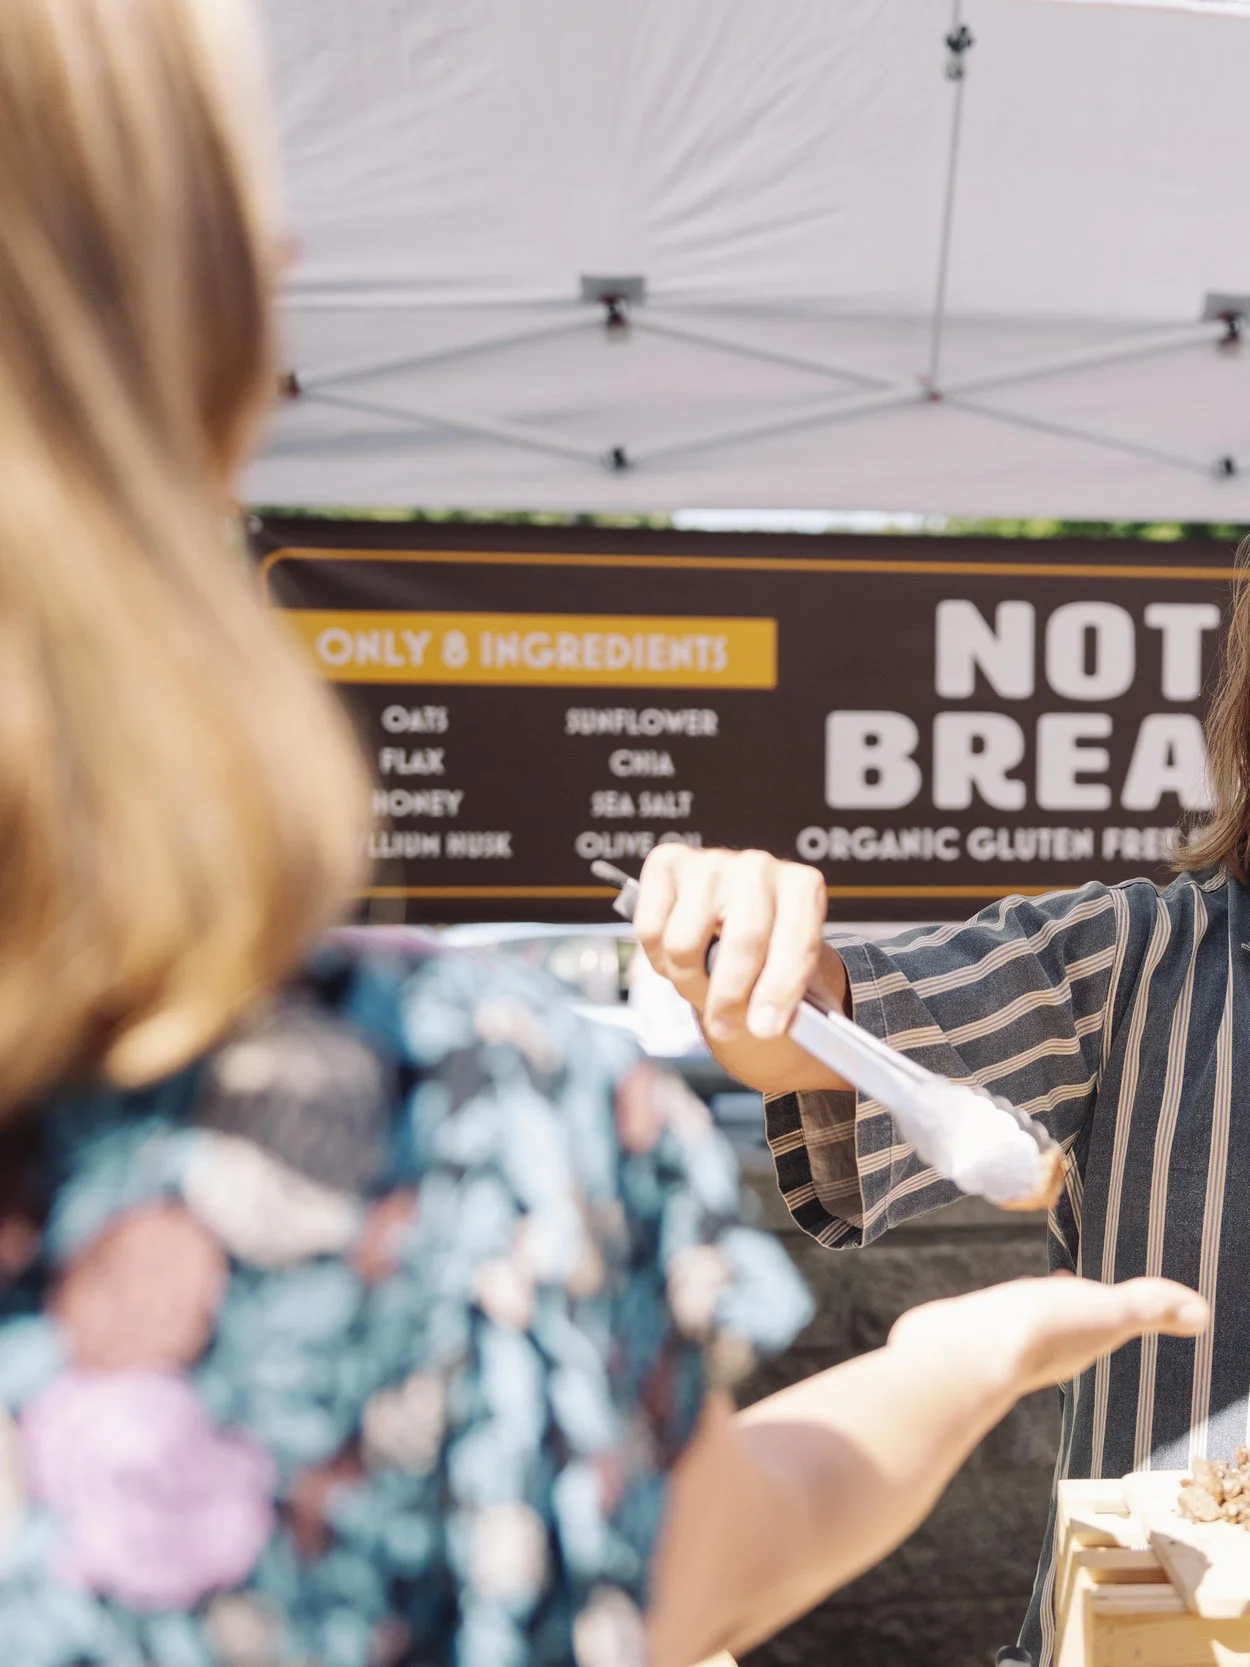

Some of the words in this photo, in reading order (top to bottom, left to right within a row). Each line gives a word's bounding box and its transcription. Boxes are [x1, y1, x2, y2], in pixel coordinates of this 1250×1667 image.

[317, 628, 430, 667] ONLY
[442, 631, 468, 667] 8
[481, 632, 728, 671] INGREDIENTS
[935, 599, 1221, 700] NOT
[381, 705, 448, 733] OATS
[565, 708, 718, 736] SUNFLOWER
[379, 748, 445, 775] FLAX
[609, 749, 675, 777] CHIA
[825, 710, 1217, 811] BREA
[371, 789, 463, 817] HONEY
[591, 790, 635, 818] SEA
[639, 791, 693, 818] SALT
[362, 832, 440, 859] LLIUM
[447, 832, 512, 858] HUSK
[575, 832, 655, 860] OLIVE
[797, 825, 959, 860] ORGANIC
[967, 828, 1093, 860] GLUTEN
